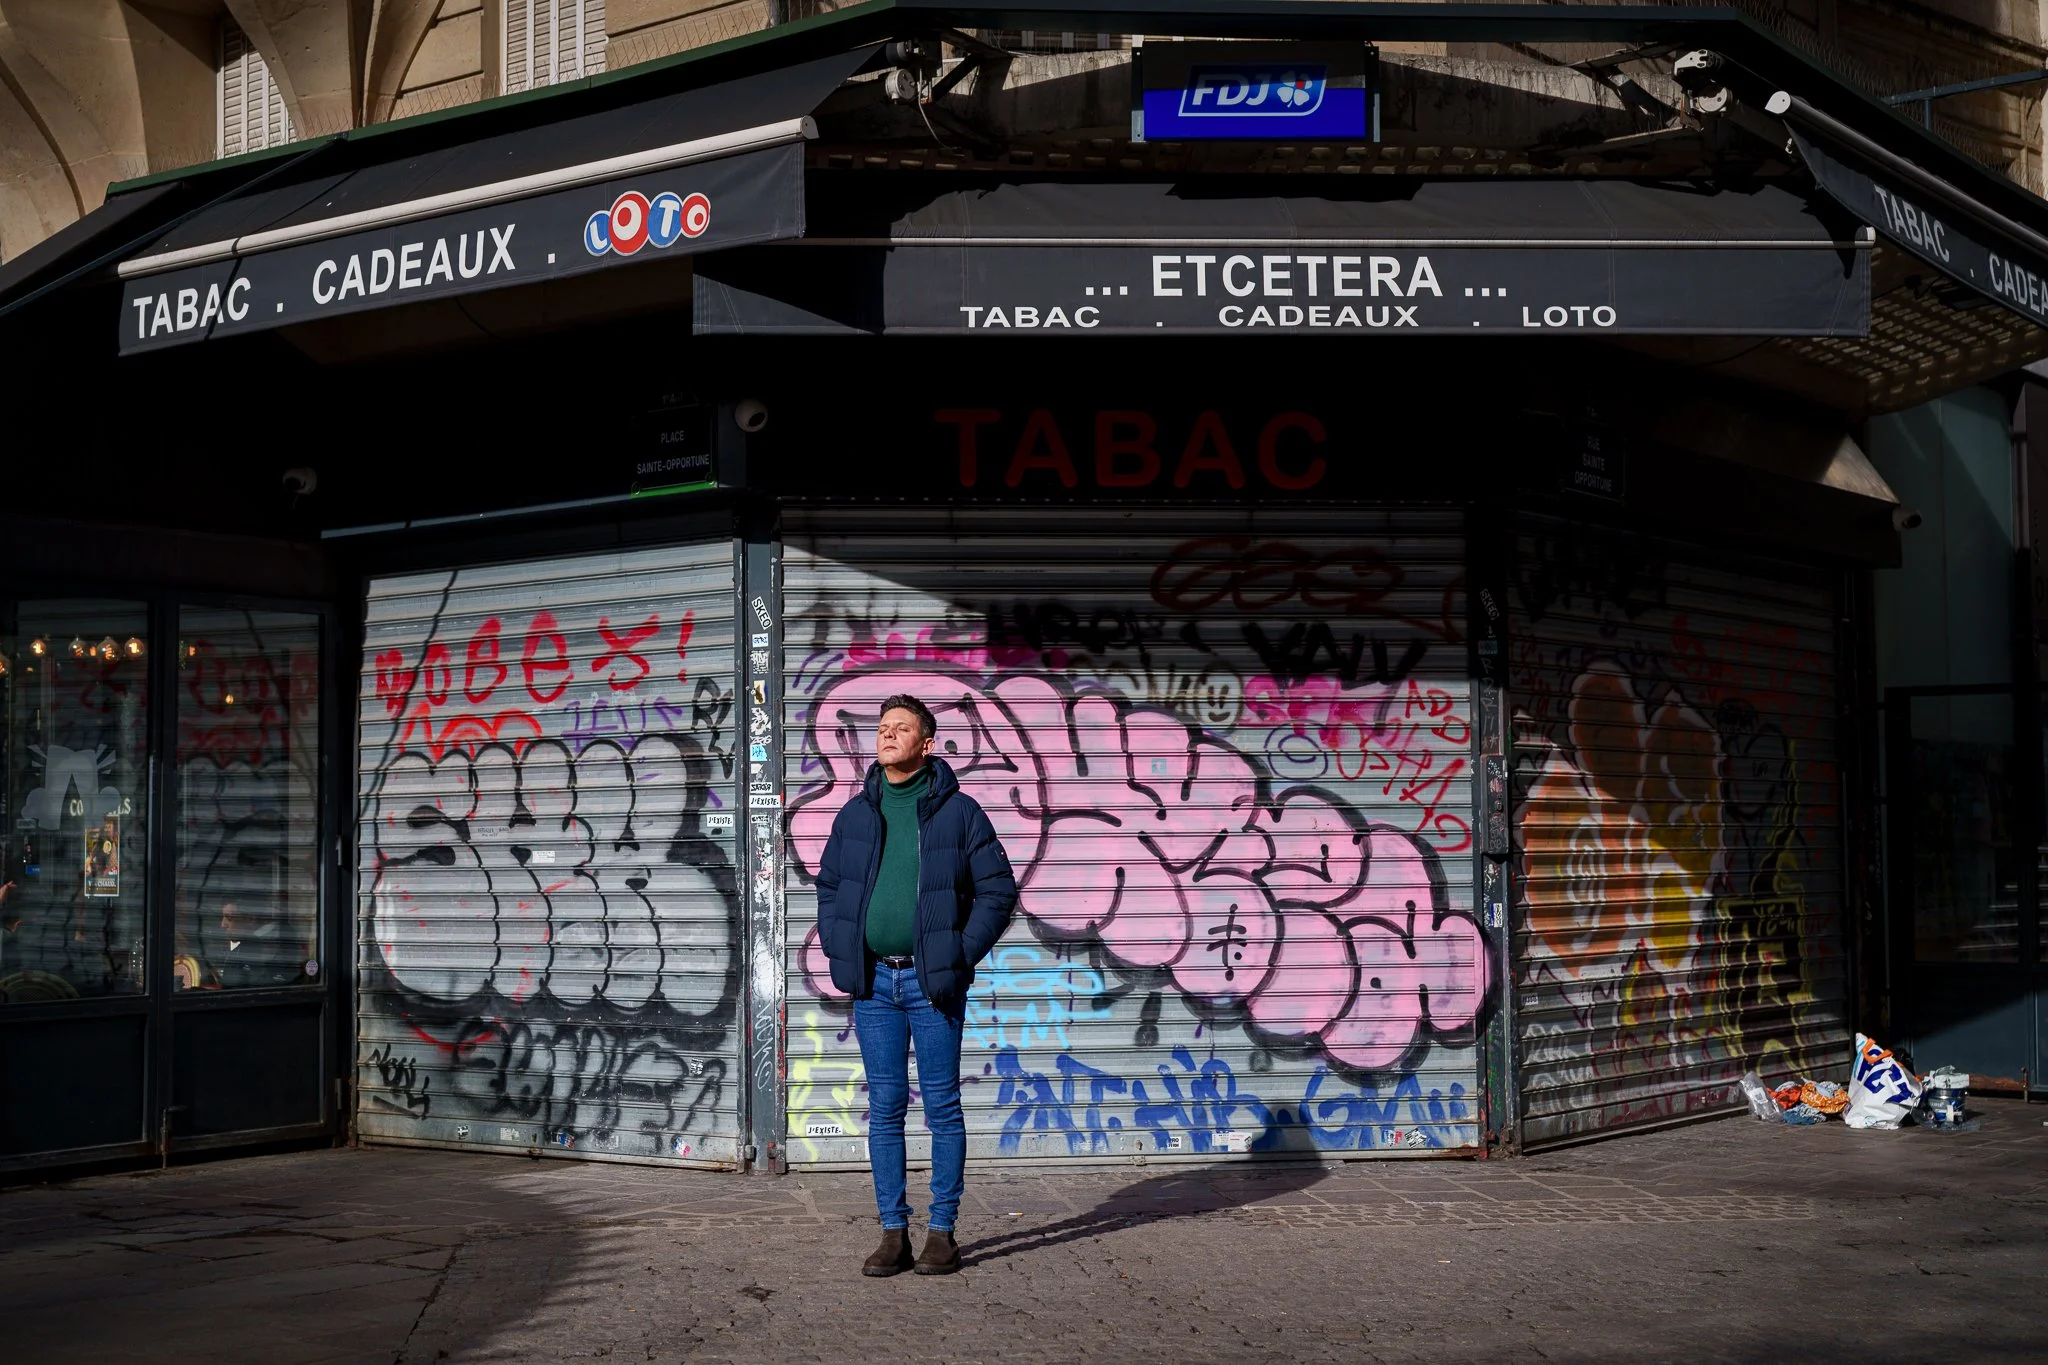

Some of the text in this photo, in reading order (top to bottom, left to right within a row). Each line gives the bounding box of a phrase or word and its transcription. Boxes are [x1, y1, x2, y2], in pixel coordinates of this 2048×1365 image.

[1192, 73, 1272, 106] FDJ
[1874, 184, 1950, 262] TABAC
[133, 276, 251, 339] TABAC
[312, 224, 516, 305] CADEAUX
[587, 197, 710, 252] LOTO
[1152, 255, 1443, 297] ETCETERA
[960, 306, 1100, 328] TABAC
[1218, 305, 1419, 327] CADEAUX
[1522, 305, 1617, 327] LOTO
[660, 430, 685, 444] PLACE
[934, 406, 1328, 490] TABAC
[636, 453, 710, 475] SAINTE-OPPORTUNE
